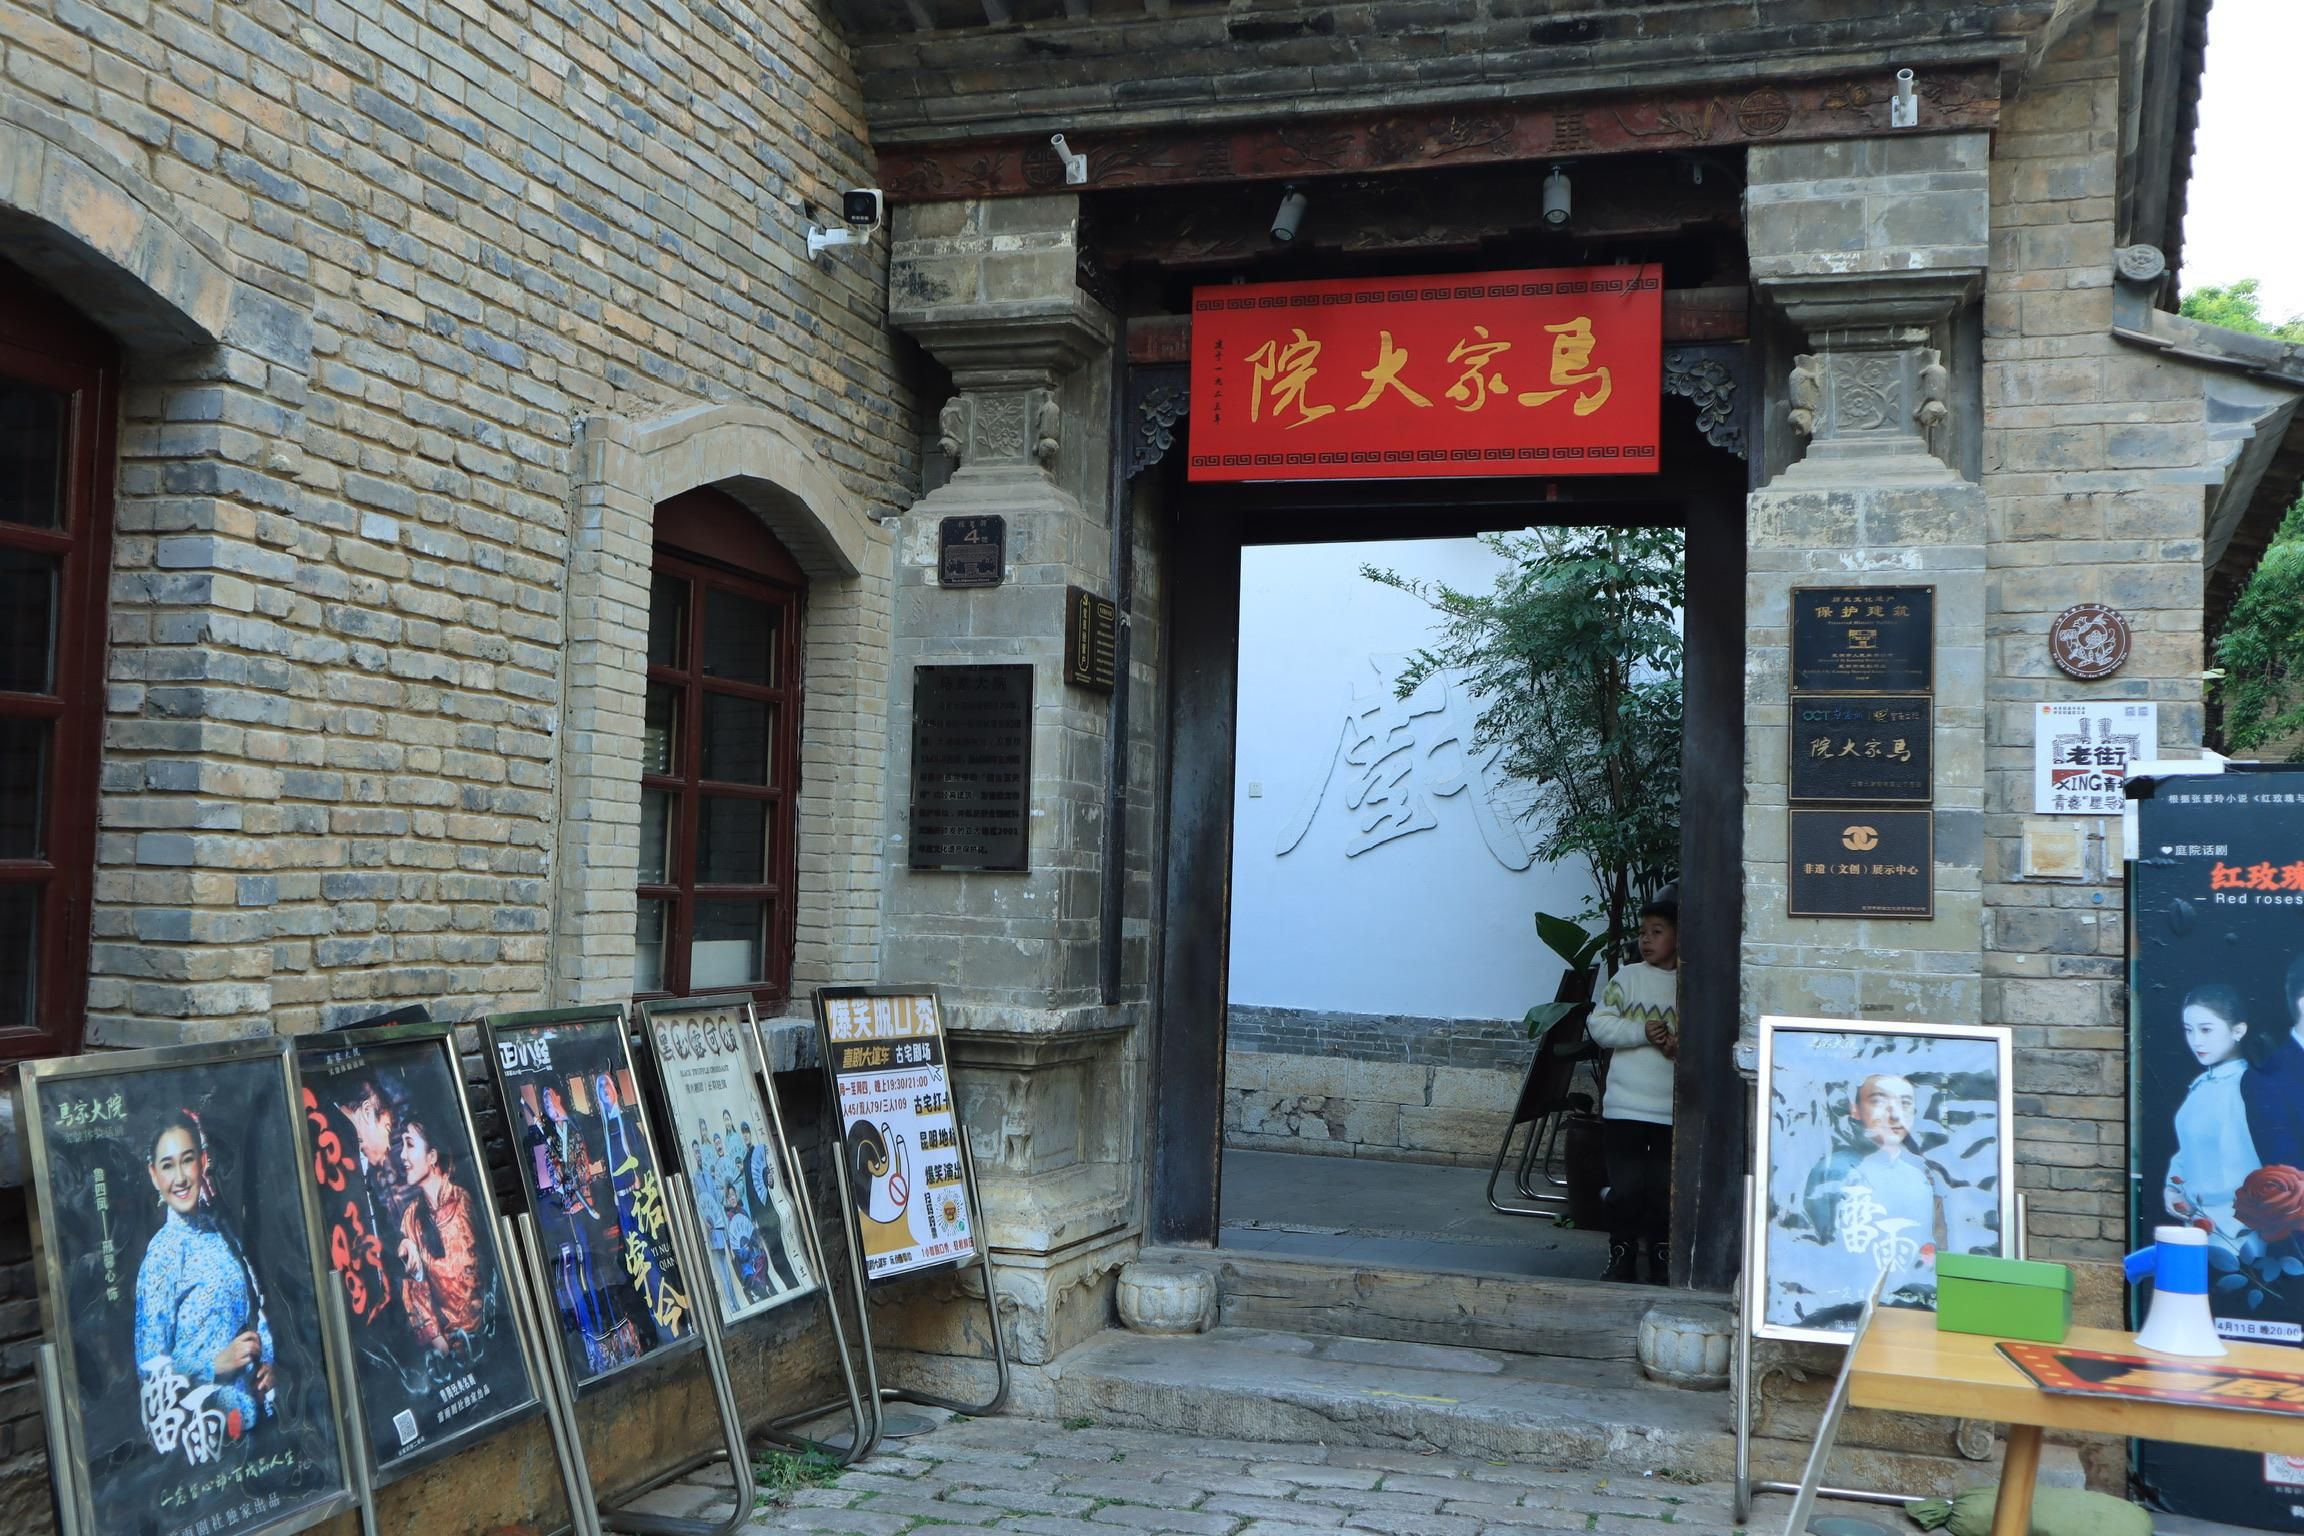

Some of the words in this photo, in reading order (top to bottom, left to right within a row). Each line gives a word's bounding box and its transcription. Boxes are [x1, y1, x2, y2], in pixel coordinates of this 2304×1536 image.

[1814, 605, 1911, 618] 保护建筑
[2066, 745, 2127, 765] 老街
[2174, 844, 2228, 857] 庭院话剧
[2215, 893, 2247, 905] Red
[2255, 895, 2304, 905] roses
[829, 998, 936, 1040] 爆笑脱口秀
[895, 1042, 932, 1064] 古宅剧场
[54, 1093, 127, 1126] 马家大院
[1835, 1184, 1921, 1273] 雷雨
[2217, 1321, 2256, 1334] 4月11日
[136, 1354, 226, 1467] 雷雨
